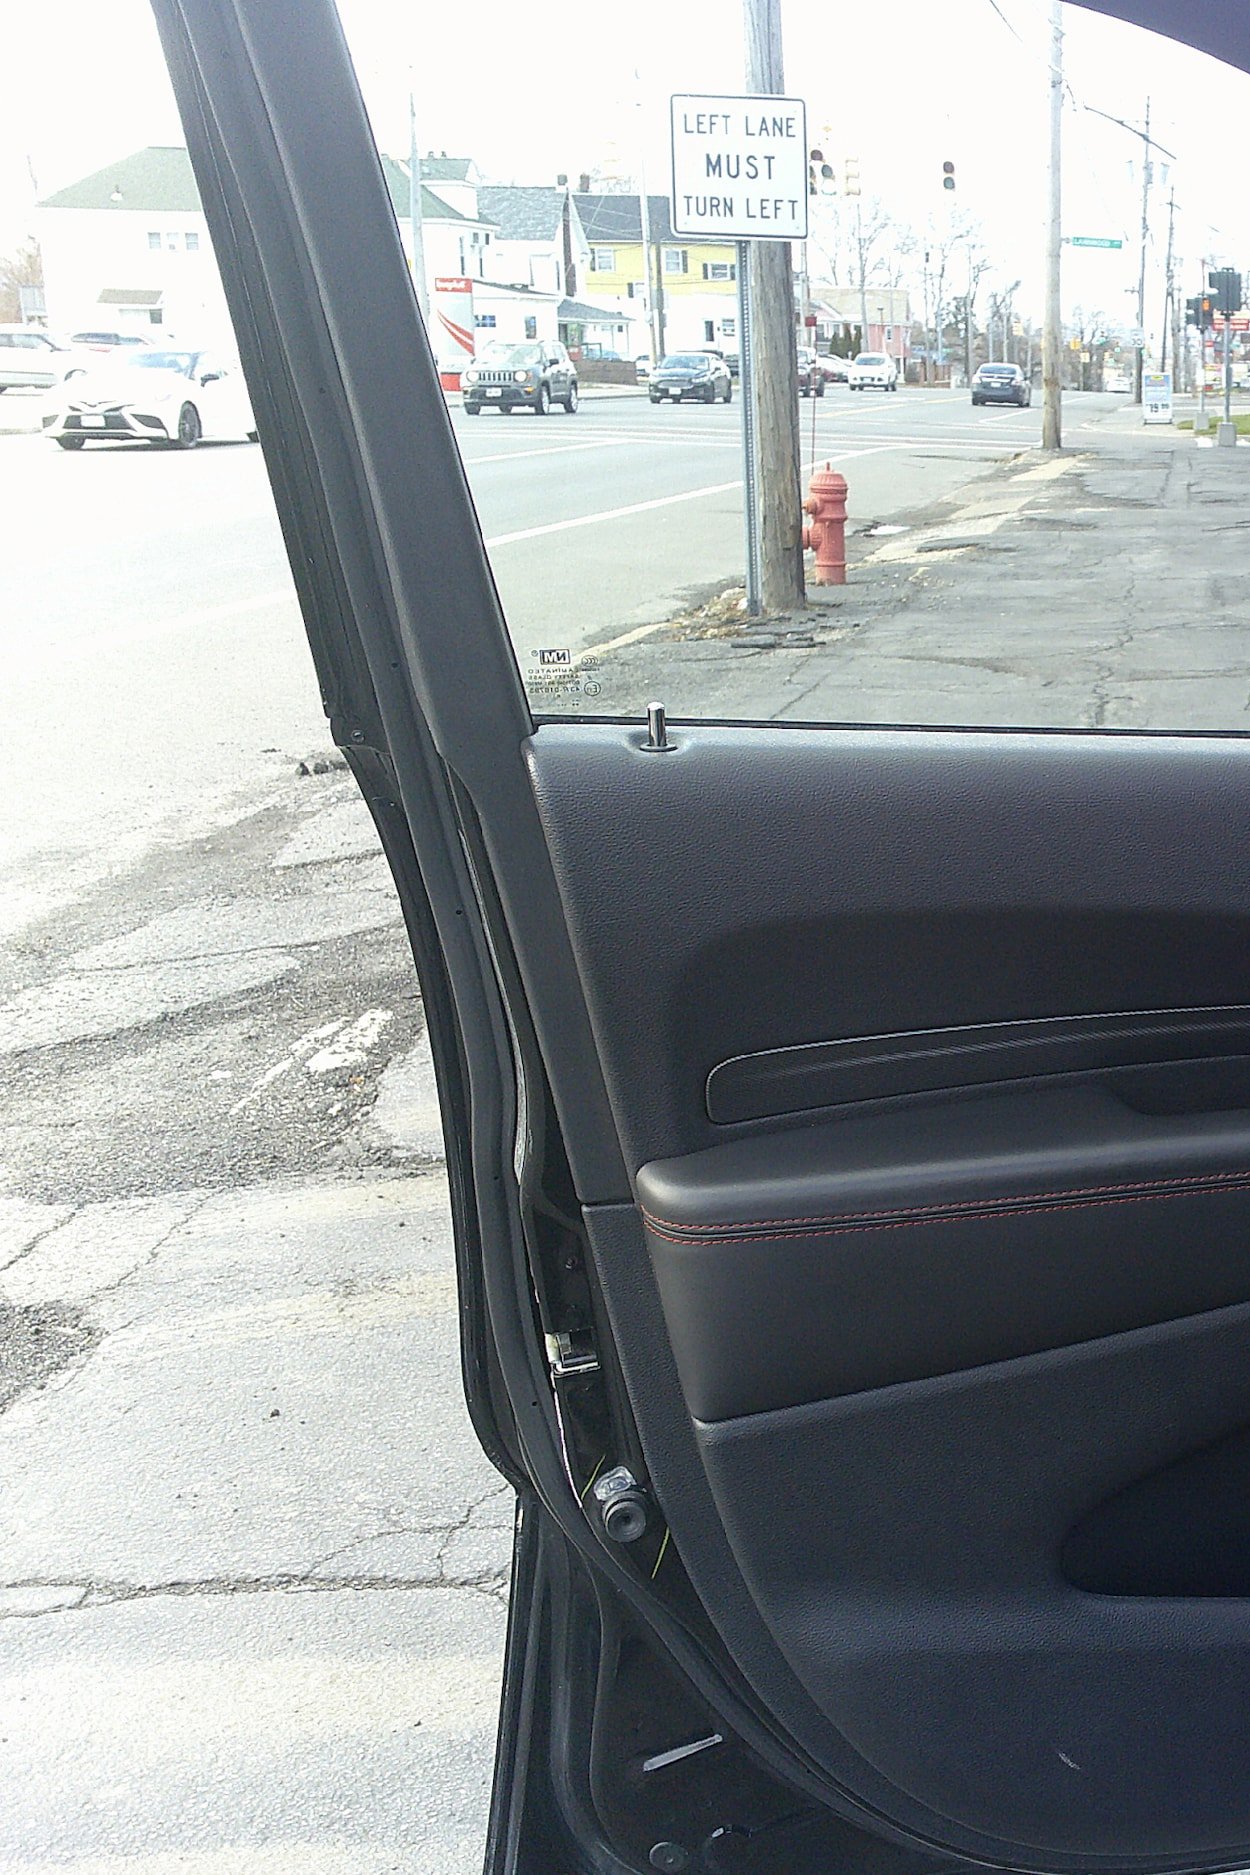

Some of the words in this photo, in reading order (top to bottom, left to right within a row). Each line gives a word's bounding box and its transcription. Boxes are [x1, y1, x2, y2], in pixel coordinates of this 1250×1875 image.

[684, 113, 731, 135] LEFT
[745, 115, 796, 138] LANE
[705, 153, 775, 180] MUST
[683, 195, 734, 218] TURN
[746, 198, 799, 220] LEFT
